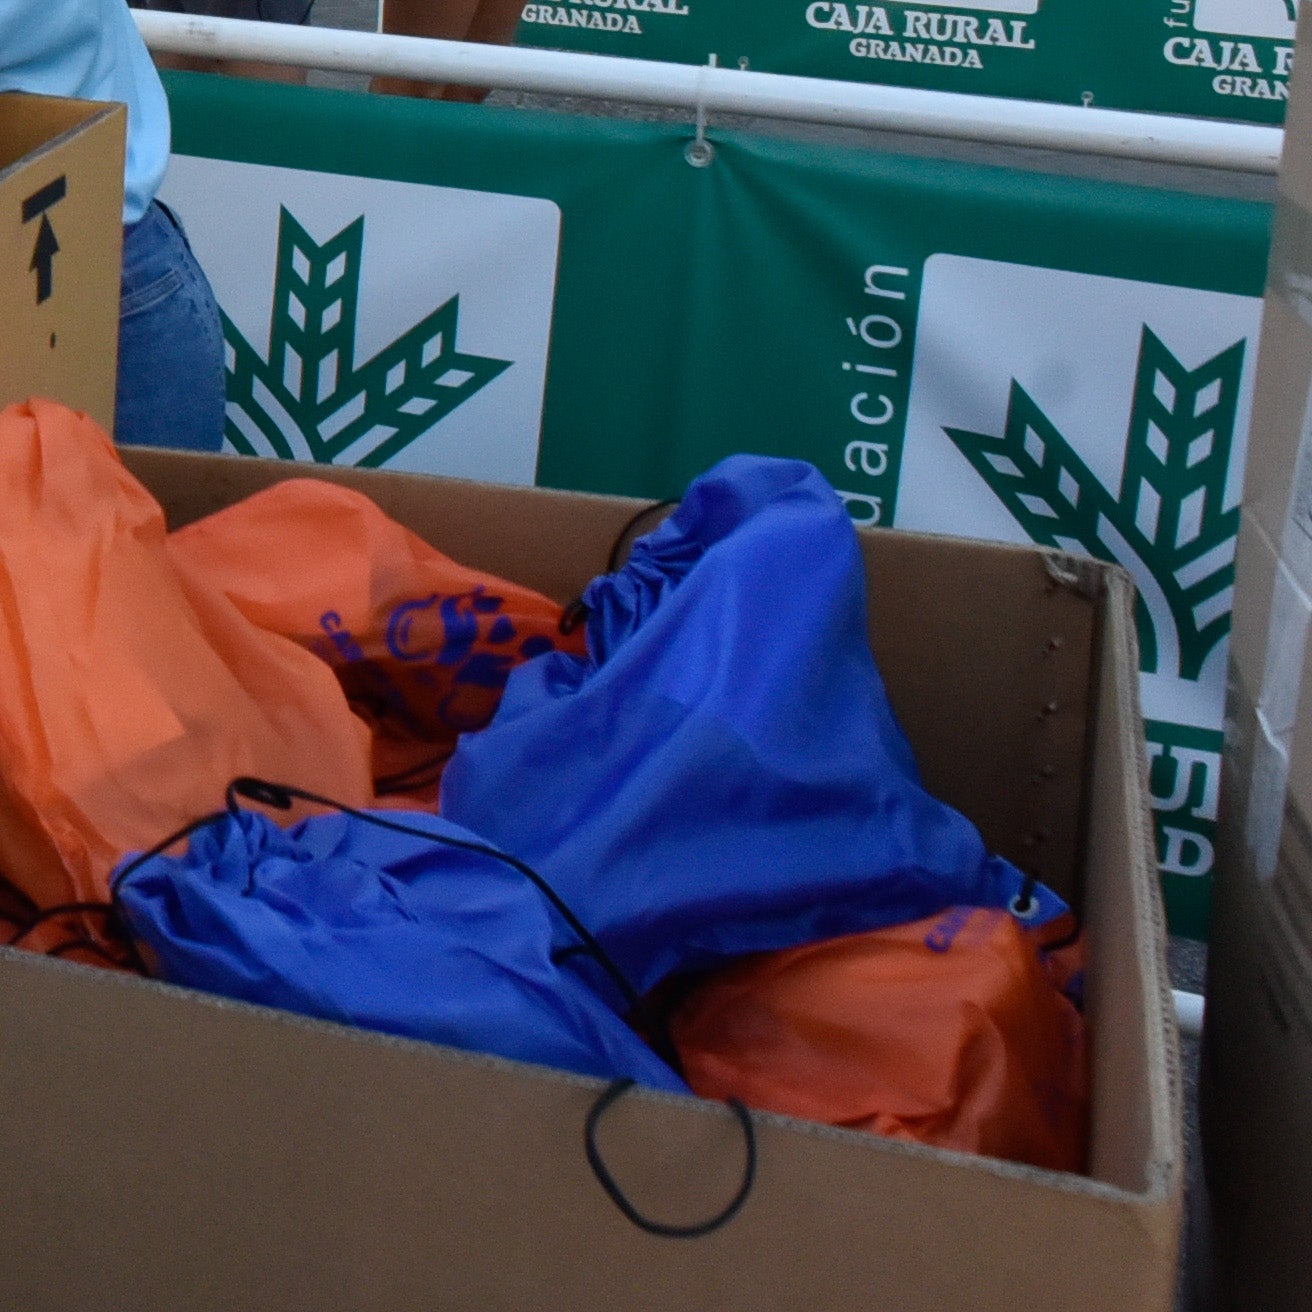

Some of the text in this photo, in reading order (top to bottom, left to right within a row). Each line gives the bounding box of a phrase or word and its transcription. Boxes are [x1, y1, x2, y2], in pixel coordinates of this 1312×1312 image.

[521, 4, 642, 34] GRANADA
[805, 1, 1035, 49] CAJA RURAL
[849, 38, 983, 69] GRANADA
[1163, 37, 1263, 73] CAJA
[1212, 75, 1289, 101] GRAN
[834, 263, 910, 527] dación
